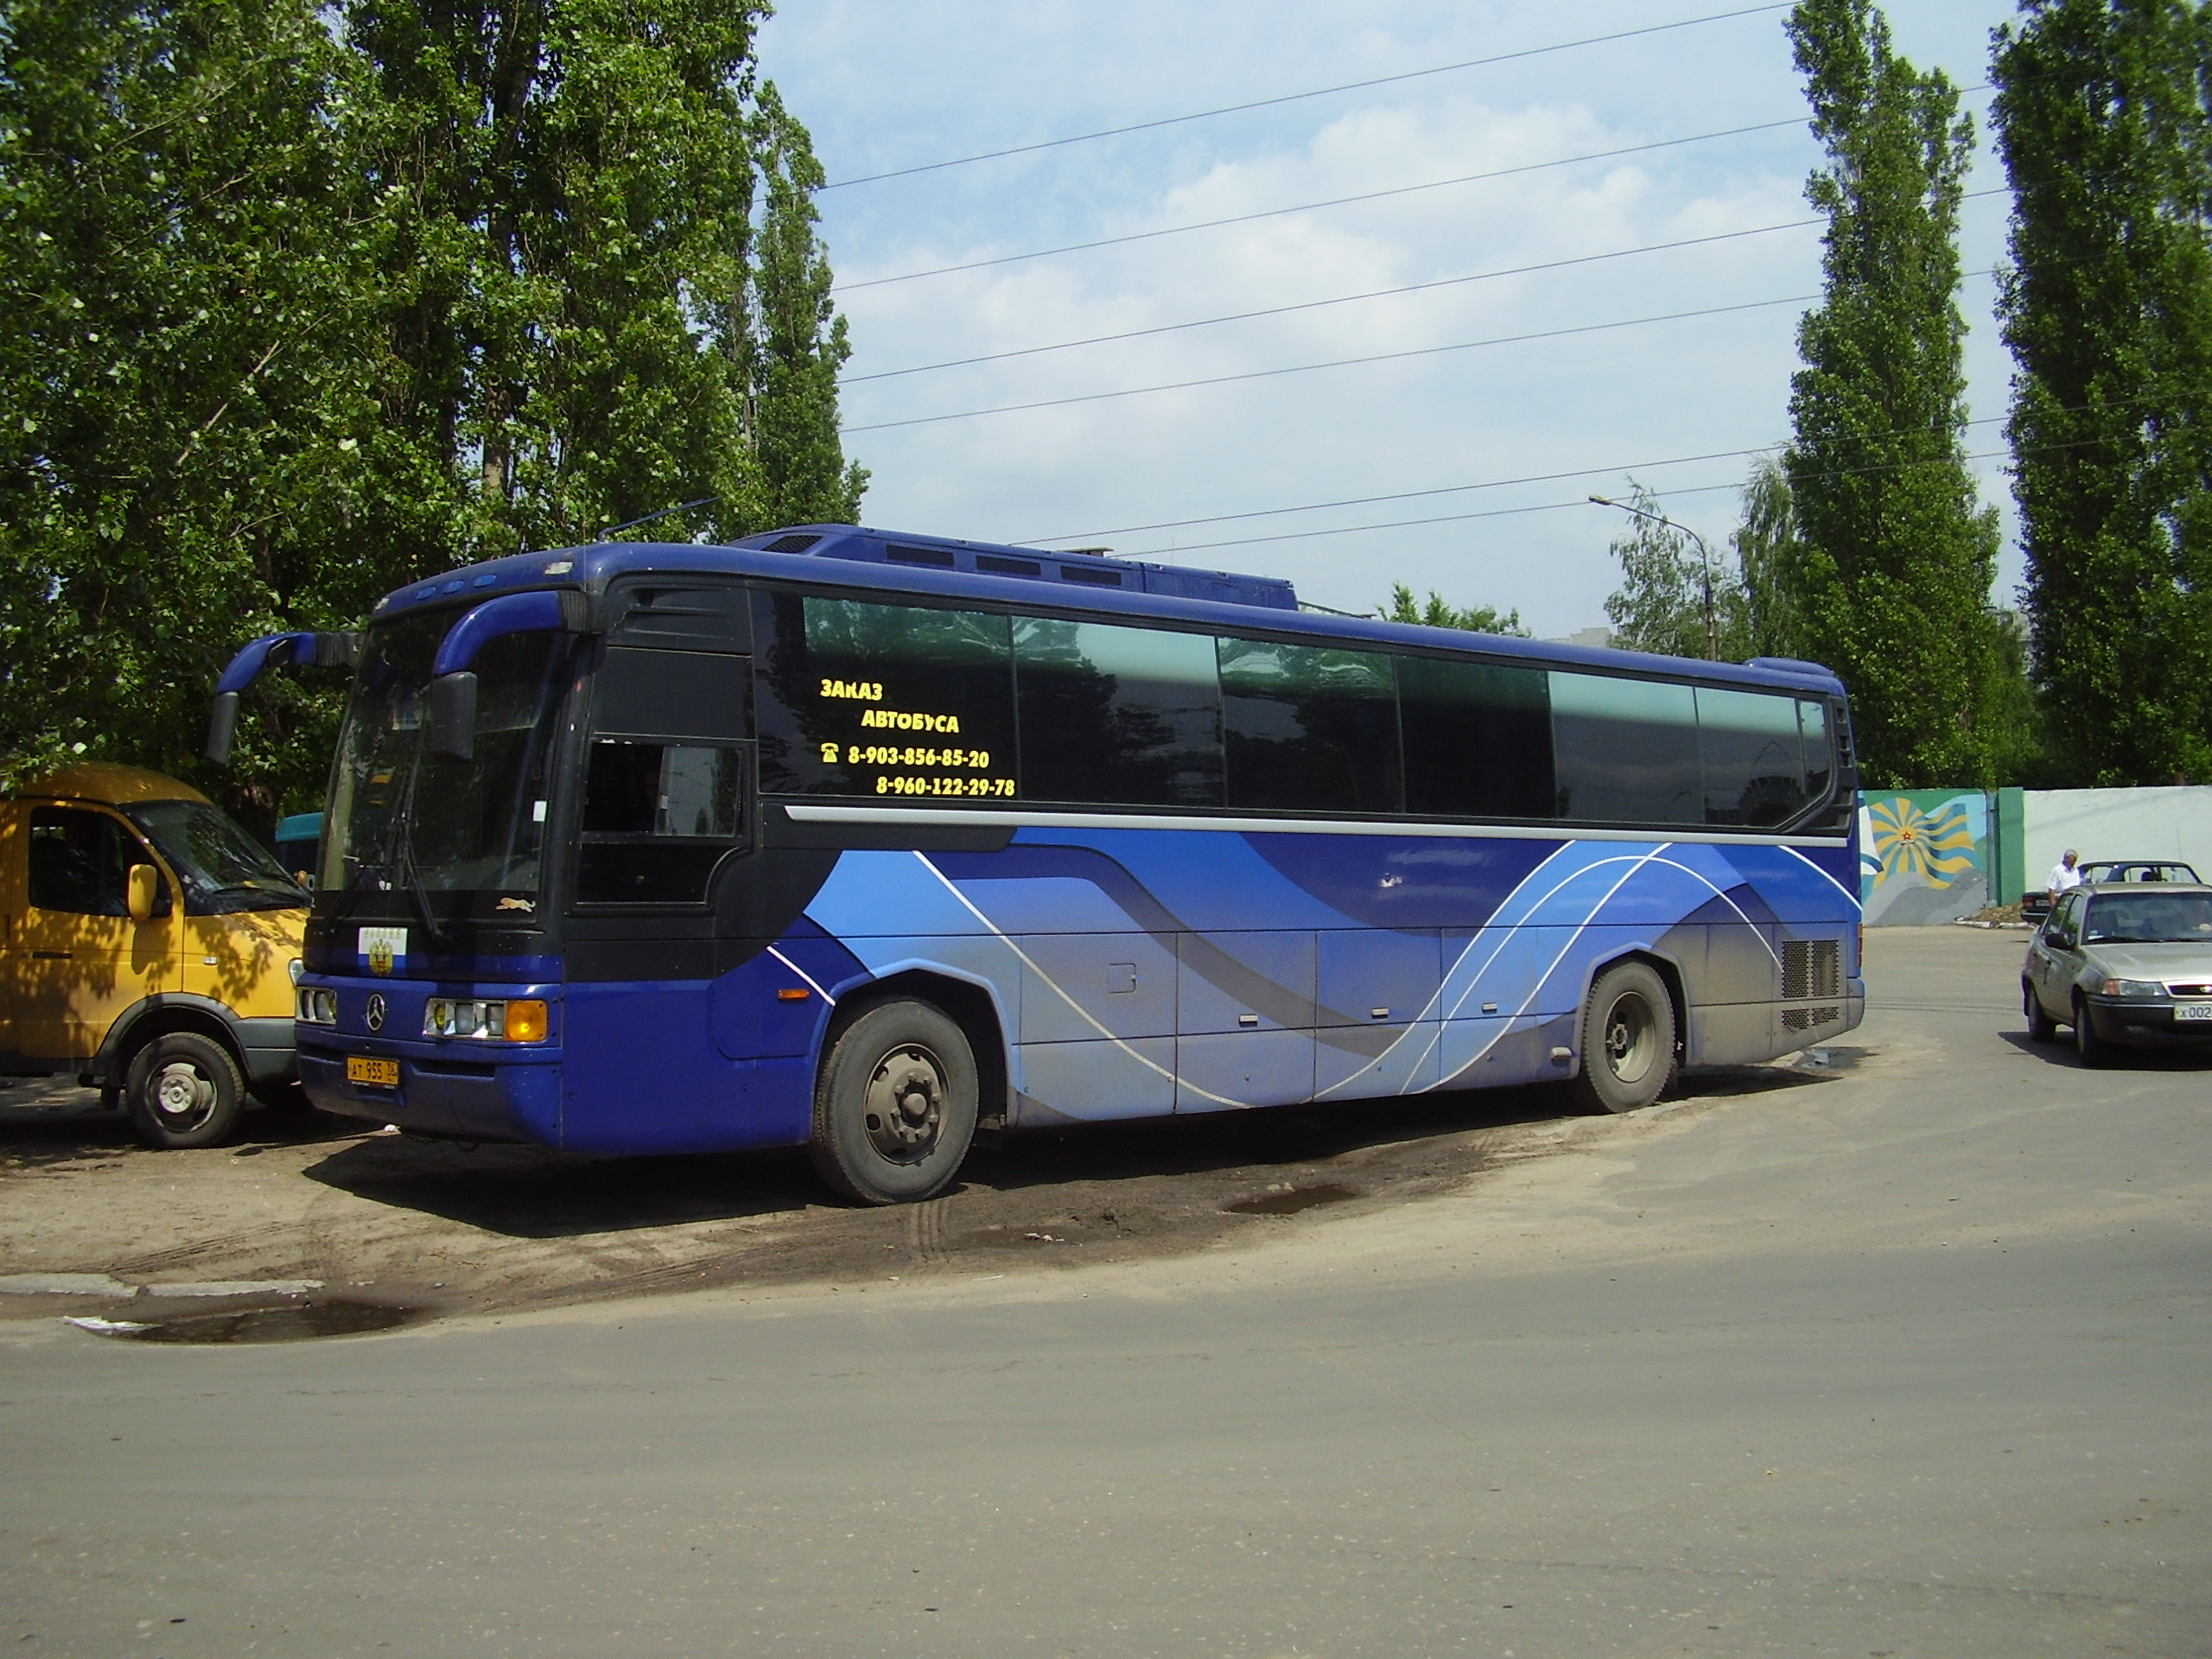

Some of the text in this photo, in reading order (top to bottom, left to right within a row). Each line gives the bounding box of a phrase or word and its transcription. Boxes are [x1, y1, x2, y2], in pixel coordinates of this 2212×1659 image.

[821, 679, 883, 701] ЗАКАЗ
[861, 709, 959, 733] АВТОБУСА
[848, 746, 989, 768] 8-903-856-85-20
[876, 776, 1015, 796] 8-960-122-29-78
